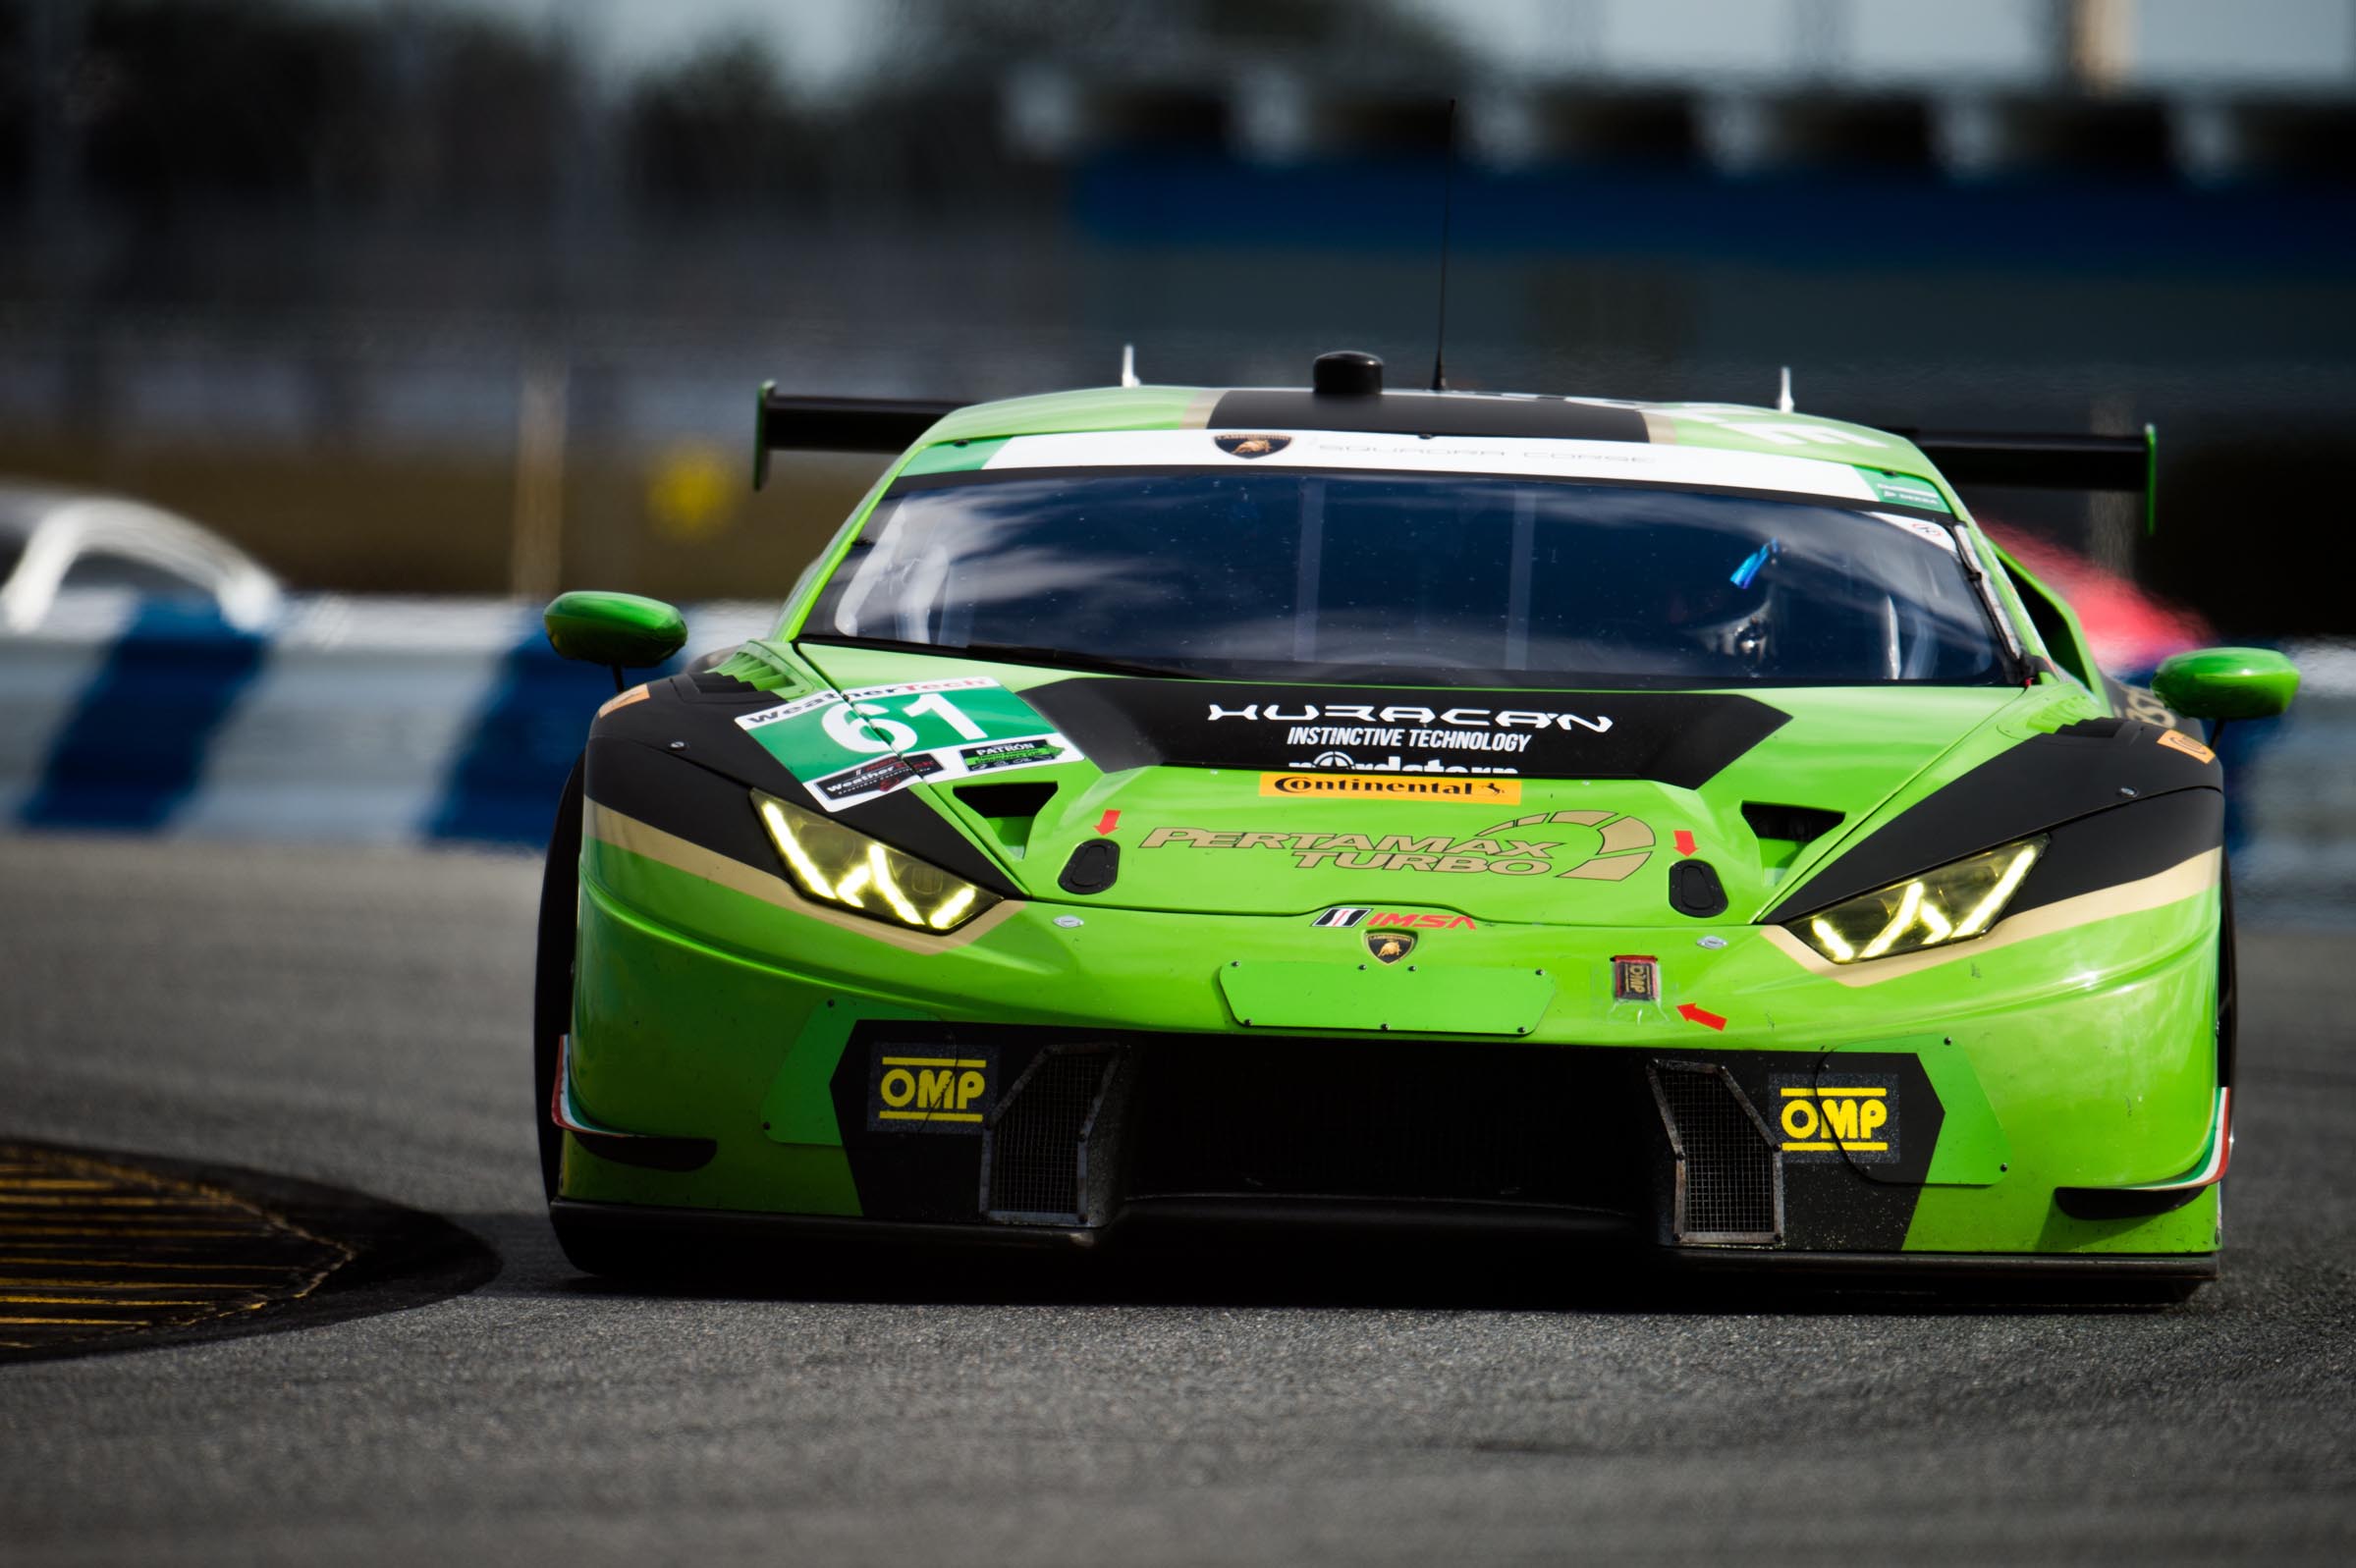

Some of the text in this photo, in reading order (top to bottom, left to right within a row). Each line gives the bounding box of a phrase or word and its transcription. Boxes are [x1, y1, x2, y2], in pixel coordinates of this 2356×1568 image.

[747, 677, 985, 724] WeatherTech
[822, 693, 989, 753] 61
[1287, 727, 1532, 752] INSTINCTIVE TECHNOLOGY
[1274, 777, 1473, 795] Continental
[1138, 827, 1566, 859] PERTAMAX
[1291, 851, 1553, 875] TURBO
[1366, 912, 1477, 930] IMSA
[880, 1068, 986, 1110] OMP
[1781, 1099, 1888, 1139] OMP
